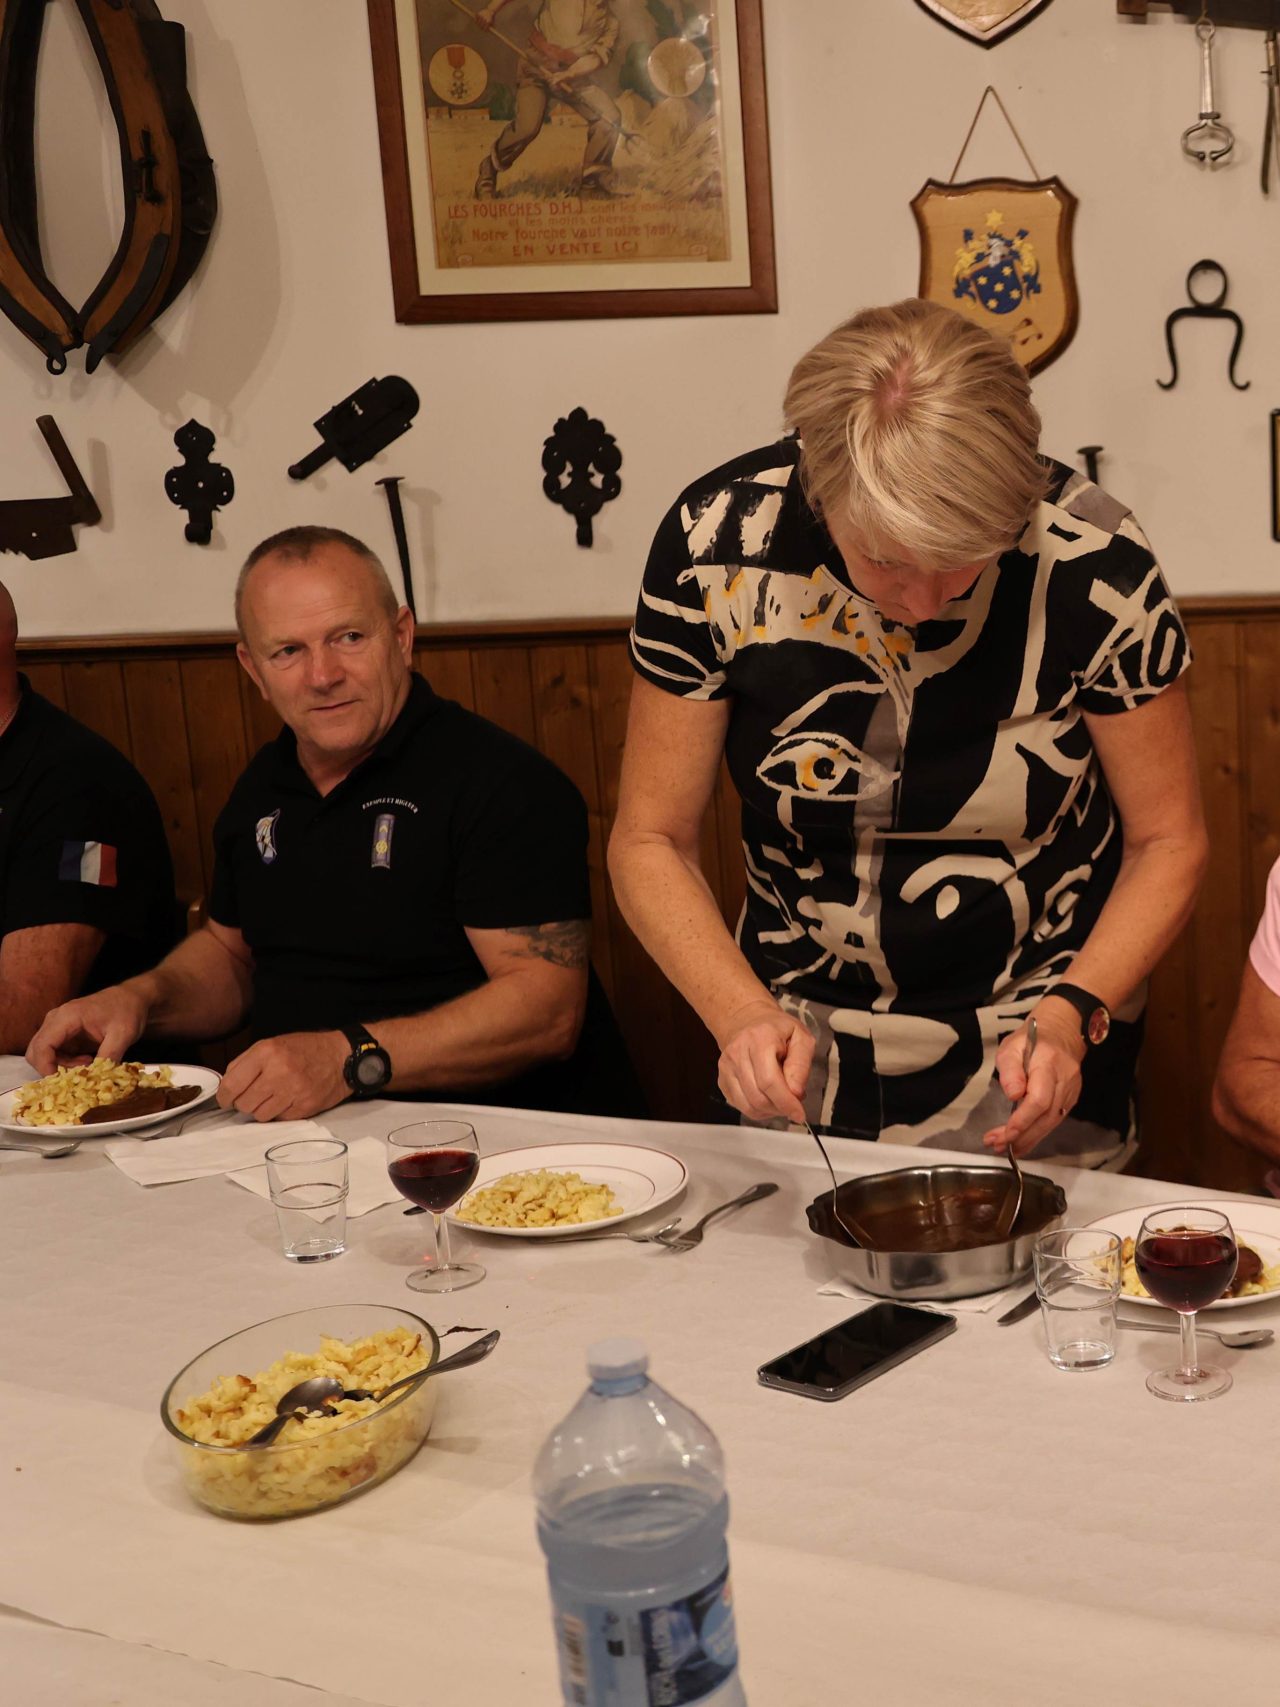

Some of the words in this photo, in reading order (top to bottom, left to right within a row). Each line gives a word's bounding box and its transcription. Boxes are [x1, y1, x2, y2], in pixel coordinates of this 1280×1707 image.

[448, 204, 469, 220] LES
[473, 202, 542, 219] FOURCHES
[526, 215, 543, 227] les
[548, 215, 586, 226] moins
[472, 228, 509, 242] Notre
[515, 227, 567, 243] fourche
[572, 225, 603, 239] vaut
[606, 224, 641, 238] notre
[512, 245, 534, 257] EN
[546, 243, 602, 256] VENTE
[614, 241, 639, 253] ICI
